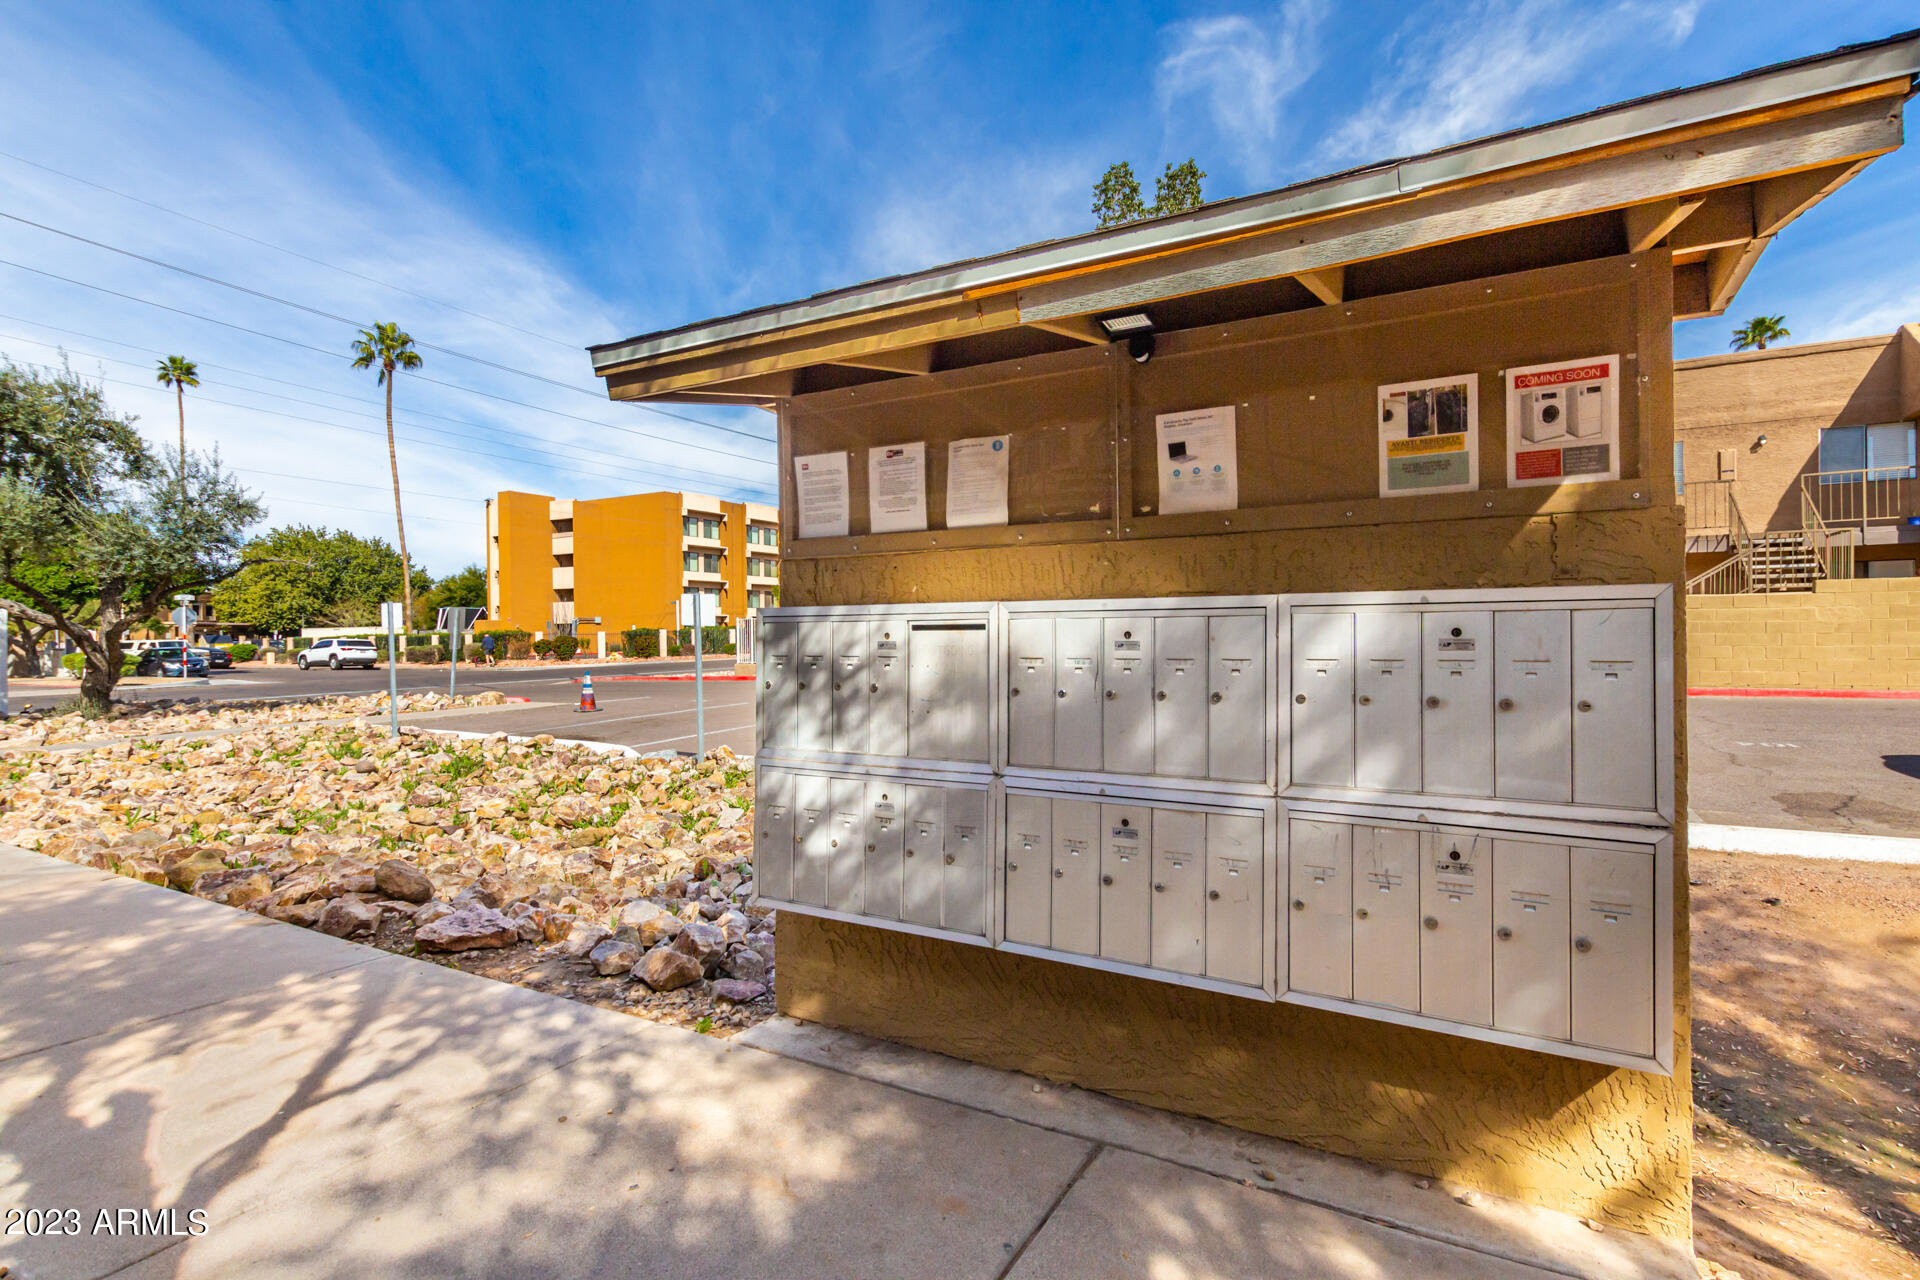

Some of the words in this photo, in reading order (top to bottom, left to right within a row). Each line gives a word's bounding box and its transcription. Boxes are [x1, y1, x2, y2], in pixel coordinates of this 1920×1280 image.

[1517, 373, 1564, 387] COMING
[1566, 368, 1601, 381] SOON
[1391, 438, 1418, 448] AVANTI
